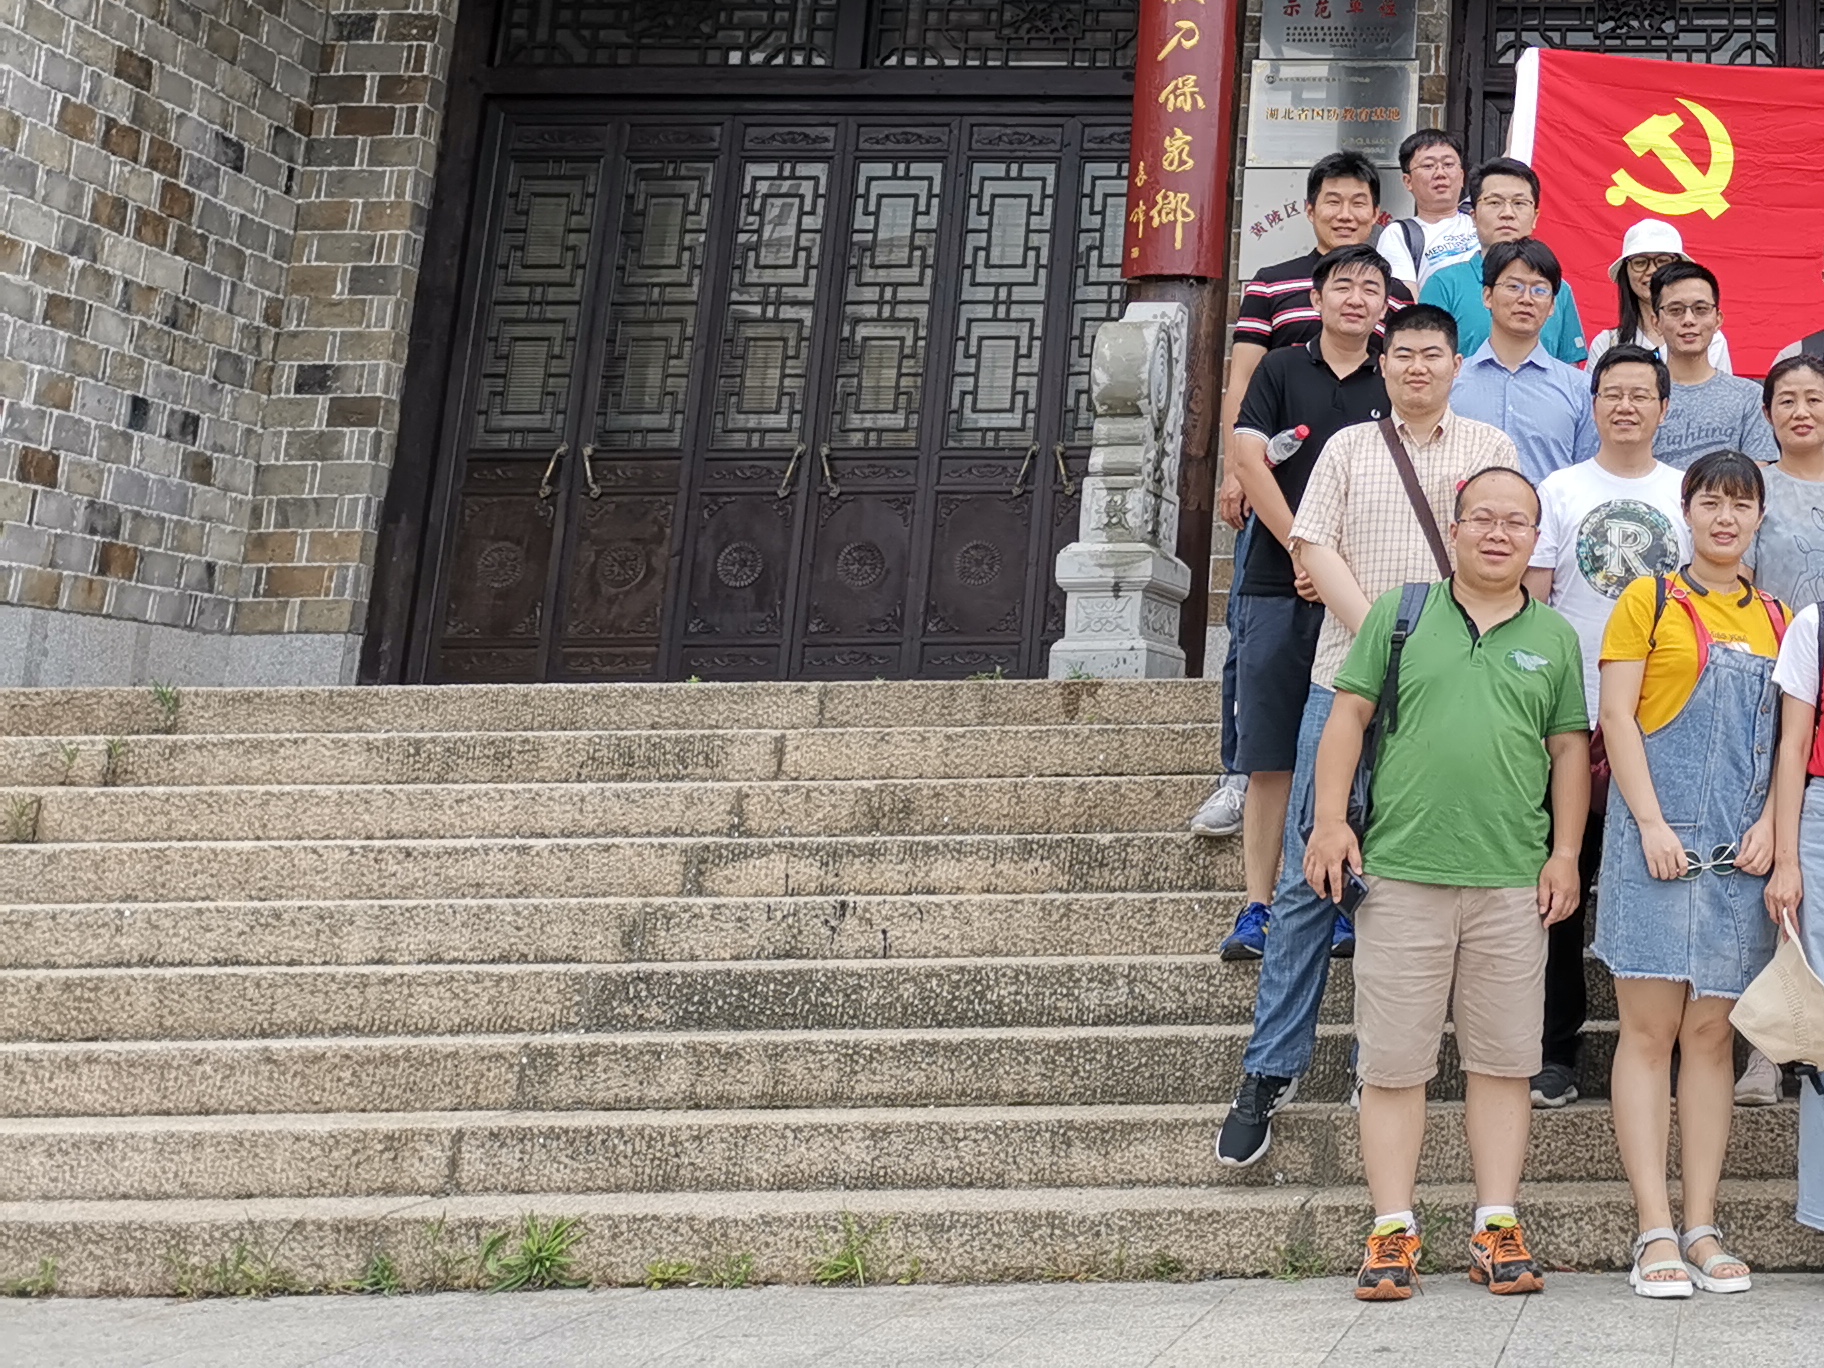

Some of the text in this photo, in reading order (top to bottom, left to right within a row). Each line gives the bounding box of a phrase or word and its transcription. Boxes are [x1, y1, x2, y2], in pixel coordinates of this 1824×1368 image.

[1265, 106, 1401, 122] 湖北省国防教育基地
